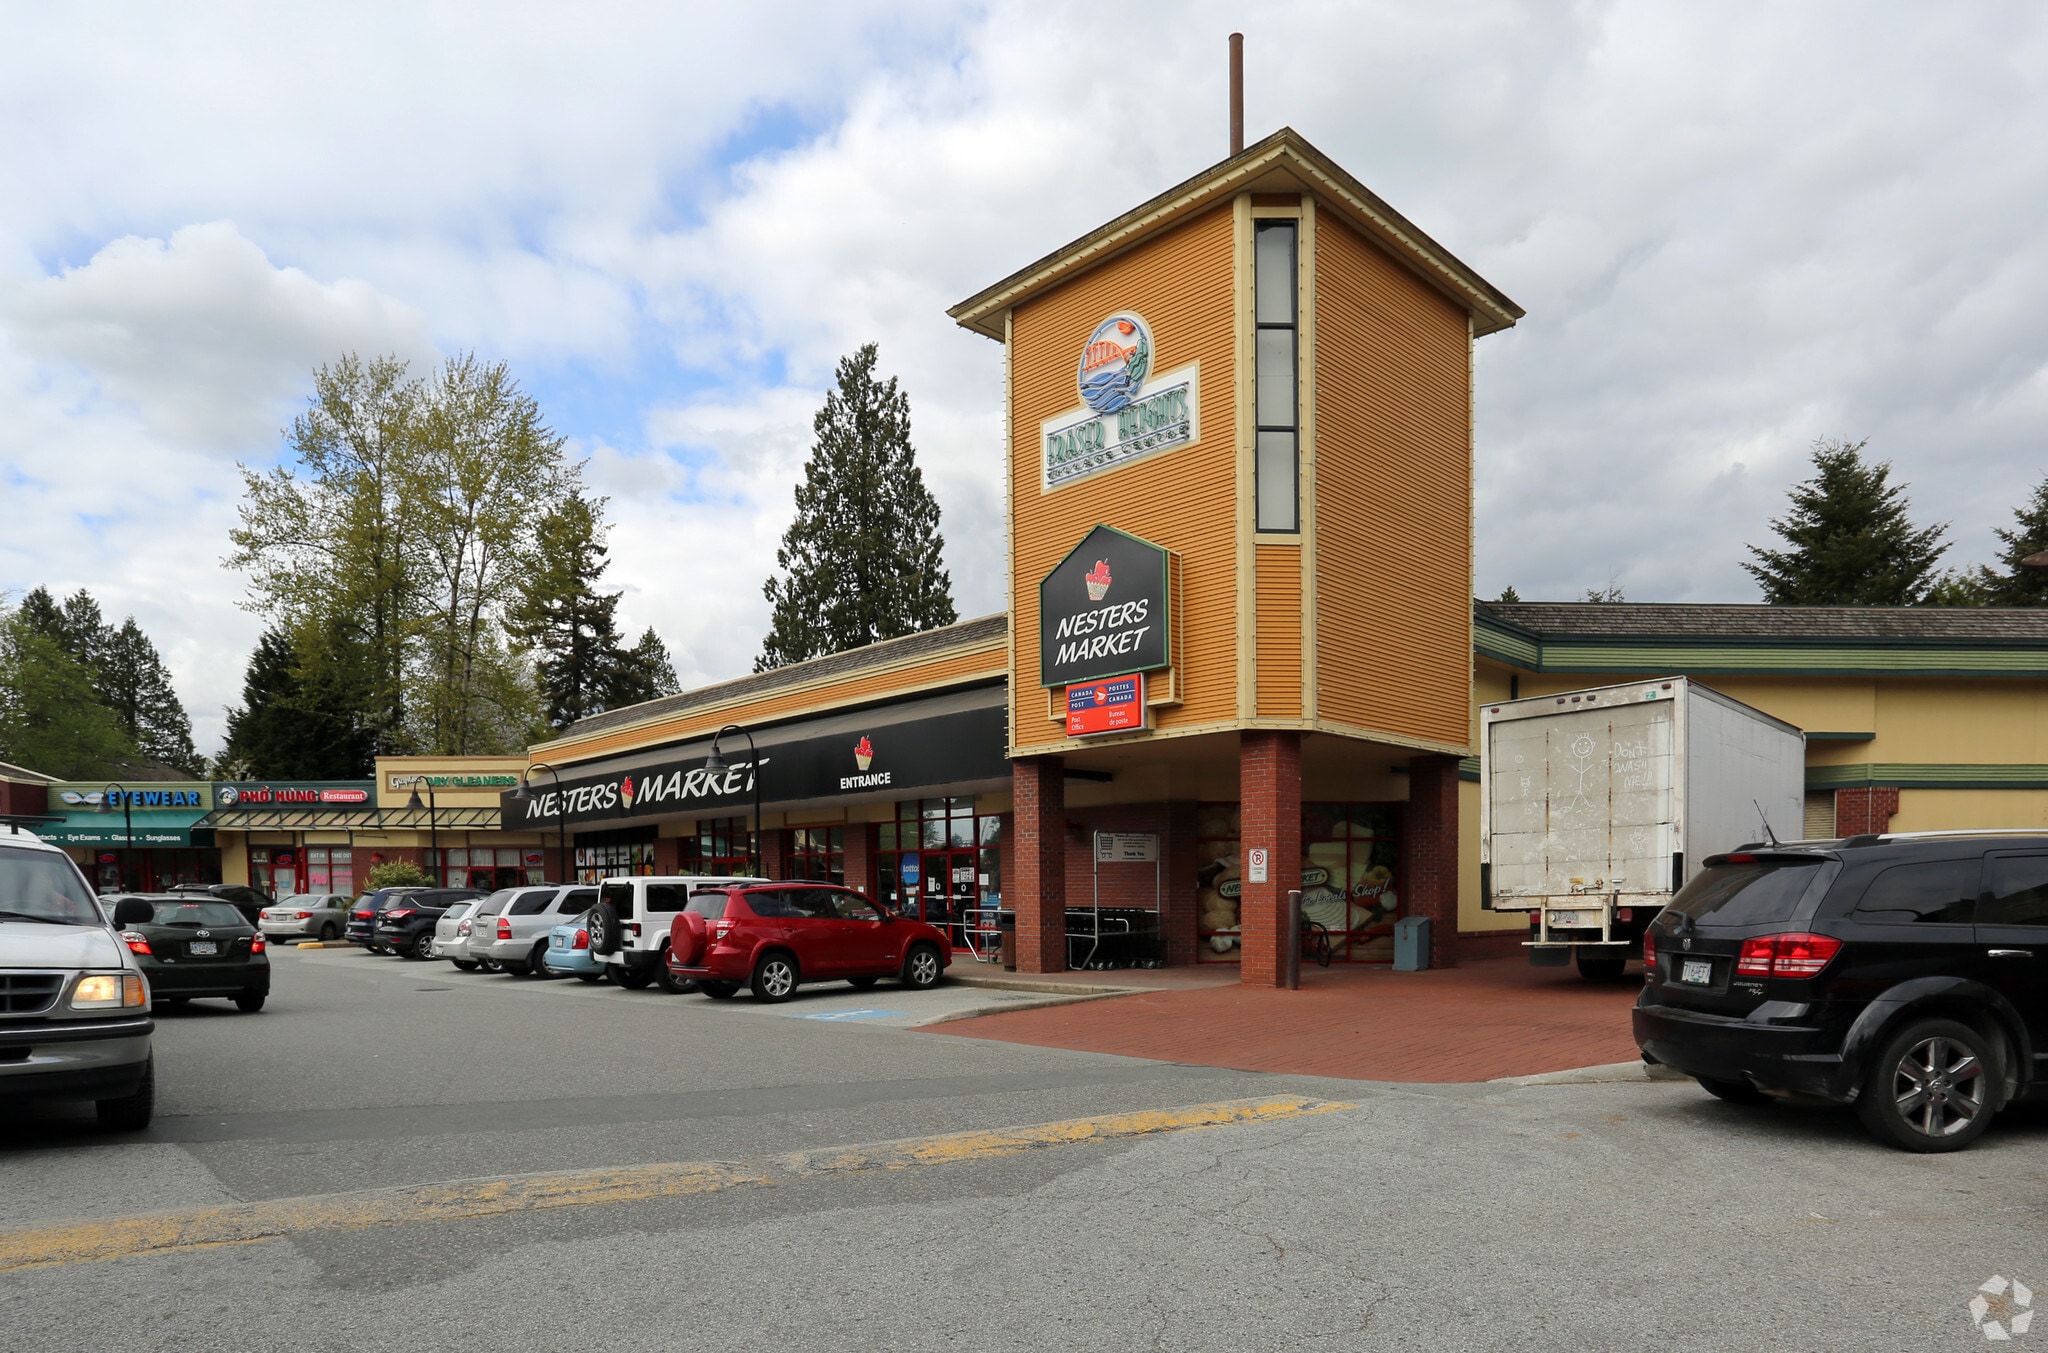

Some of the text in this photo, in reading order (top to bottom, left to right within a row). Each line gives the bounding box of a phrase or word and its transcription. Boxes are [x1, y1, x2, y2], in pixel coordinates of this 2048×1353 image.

[1055, 598, 1149, 640] NESTERS
[1054, 625, 1151, 667] MARKET
[1108, 683, 1130, 692] POSTES
[1071, 689, 1093, 698] CANADA
[1108, 694, 1132, 703] CANADA
[1071, 723, 1085, 731] Office
[1115, 718, 1129, 726] poste
[426, 776, 450, 787] DRY
[452, 775, 517, 787] CLEANERS
[840, 772, 891, 789] ENTRANCE
[526, 758, 770, 819] NESTERS MARKET
[108, 791, 199, 805] EYEWEAR
[323, 790, 364, 800] Restaurant
[67, 834, 79, 842] Eye
[145, 834, 181, 842] Sunglasses
[1352, 878, 1390, 899] Shop!
